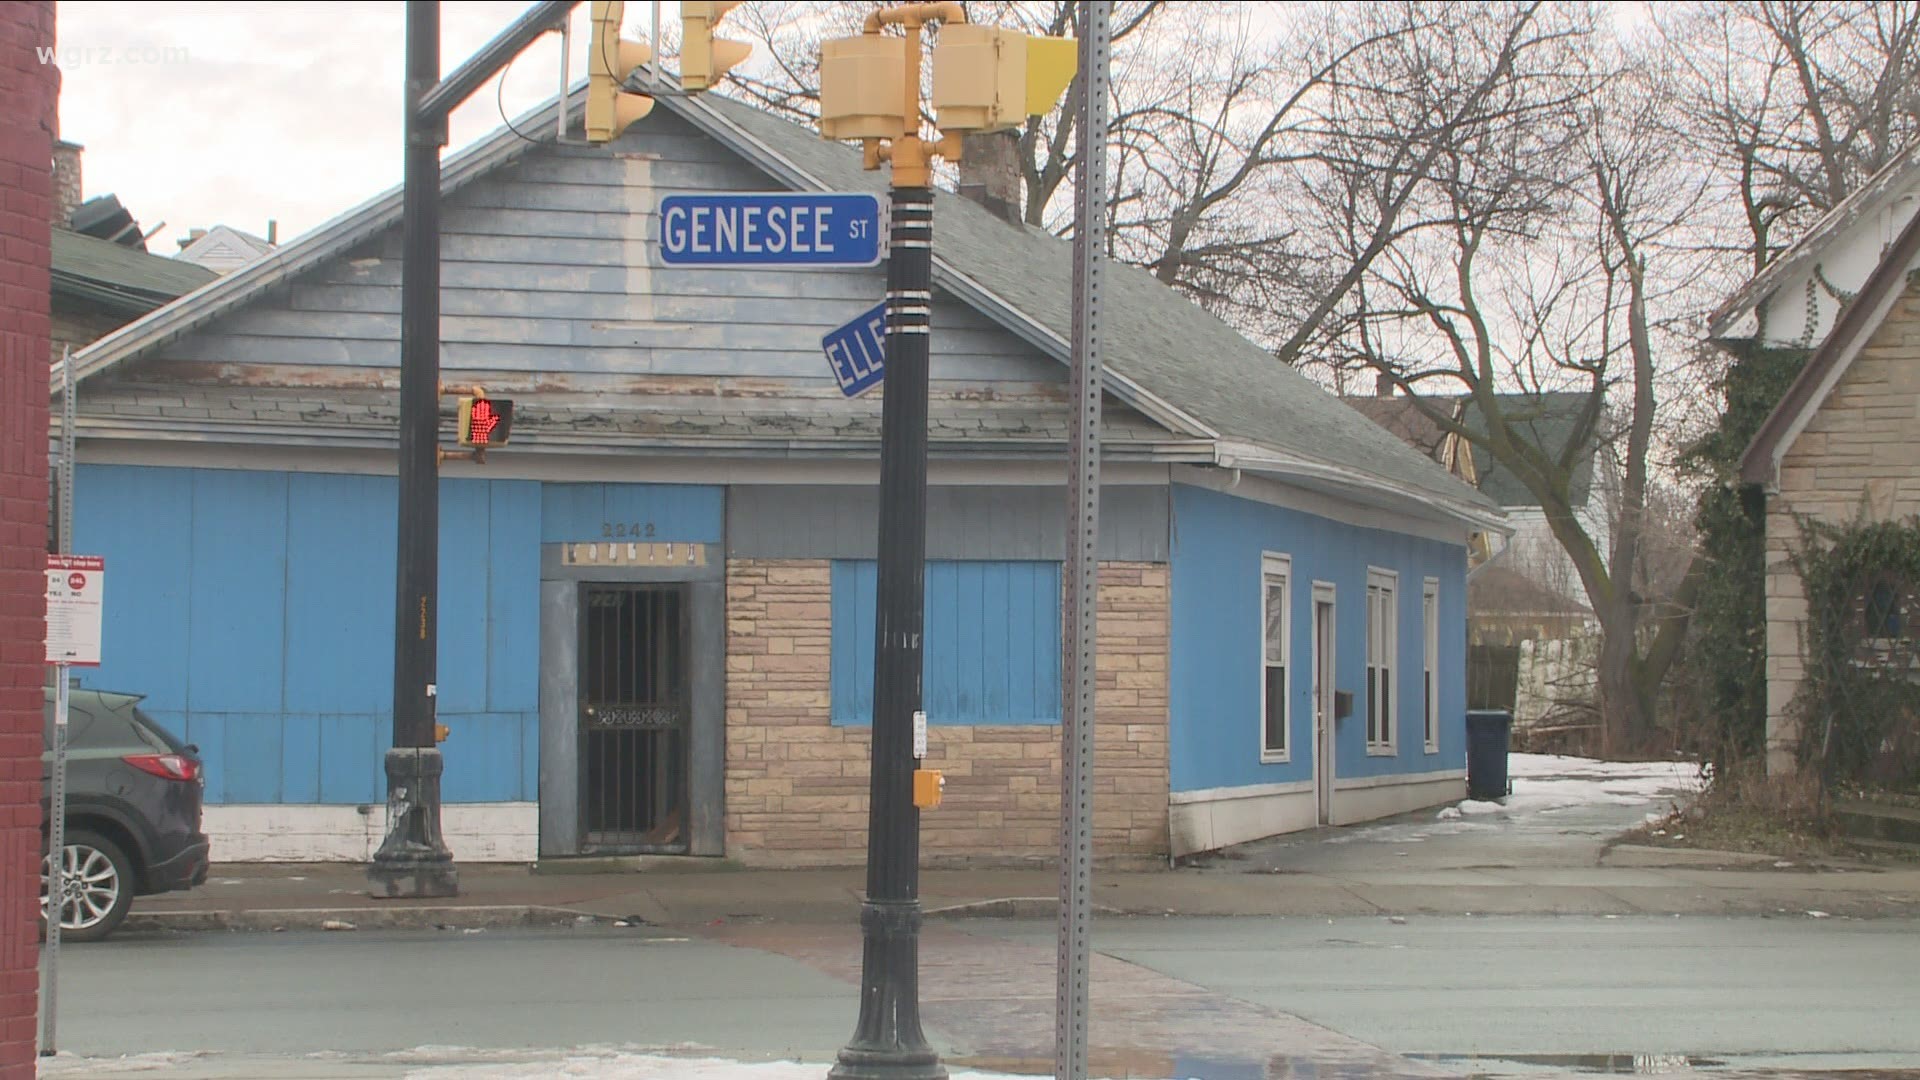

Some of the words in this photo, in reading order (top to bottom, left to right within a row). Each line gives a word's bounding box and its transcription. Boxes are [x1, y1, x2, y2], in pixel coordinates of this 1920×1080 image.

[665, 206, 835, 253] GENESEE
[849, 219, 868, 239] ST
[826, 314, 887, 389] ELLE
[602, 522, 656, 537] 2242
